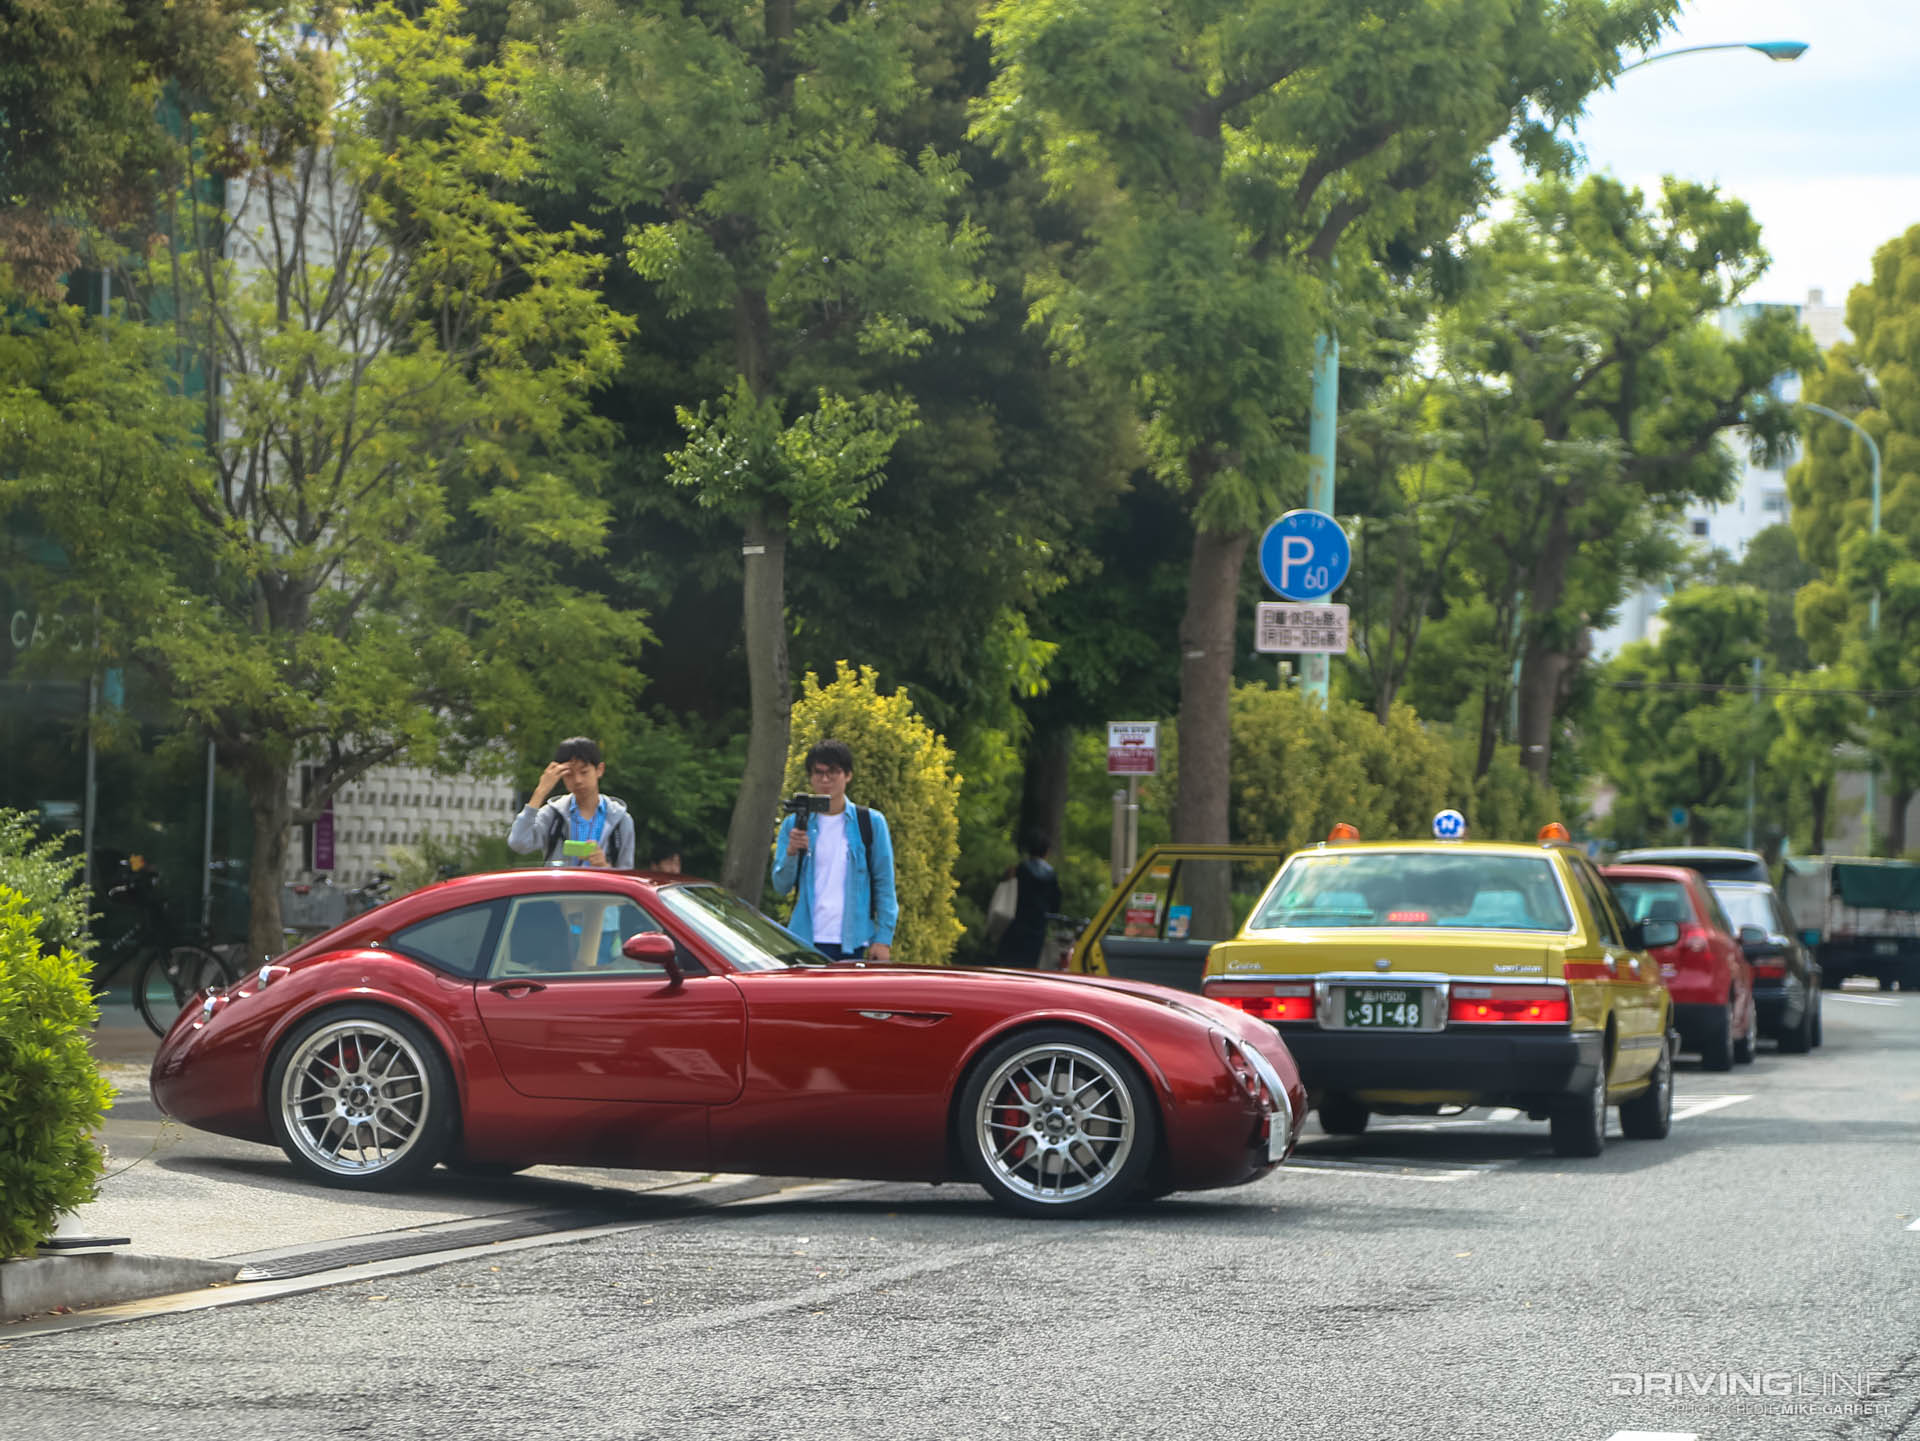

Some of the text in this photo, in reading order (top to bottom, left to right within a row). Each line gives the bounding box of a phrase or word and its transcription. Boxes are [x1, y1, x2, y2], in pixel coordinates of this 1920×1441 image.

[1281, 536, 1315, 588] P
[1304, 567, 1328, 590] 60
[1360, 1003, 1419, 1025] 91-48
